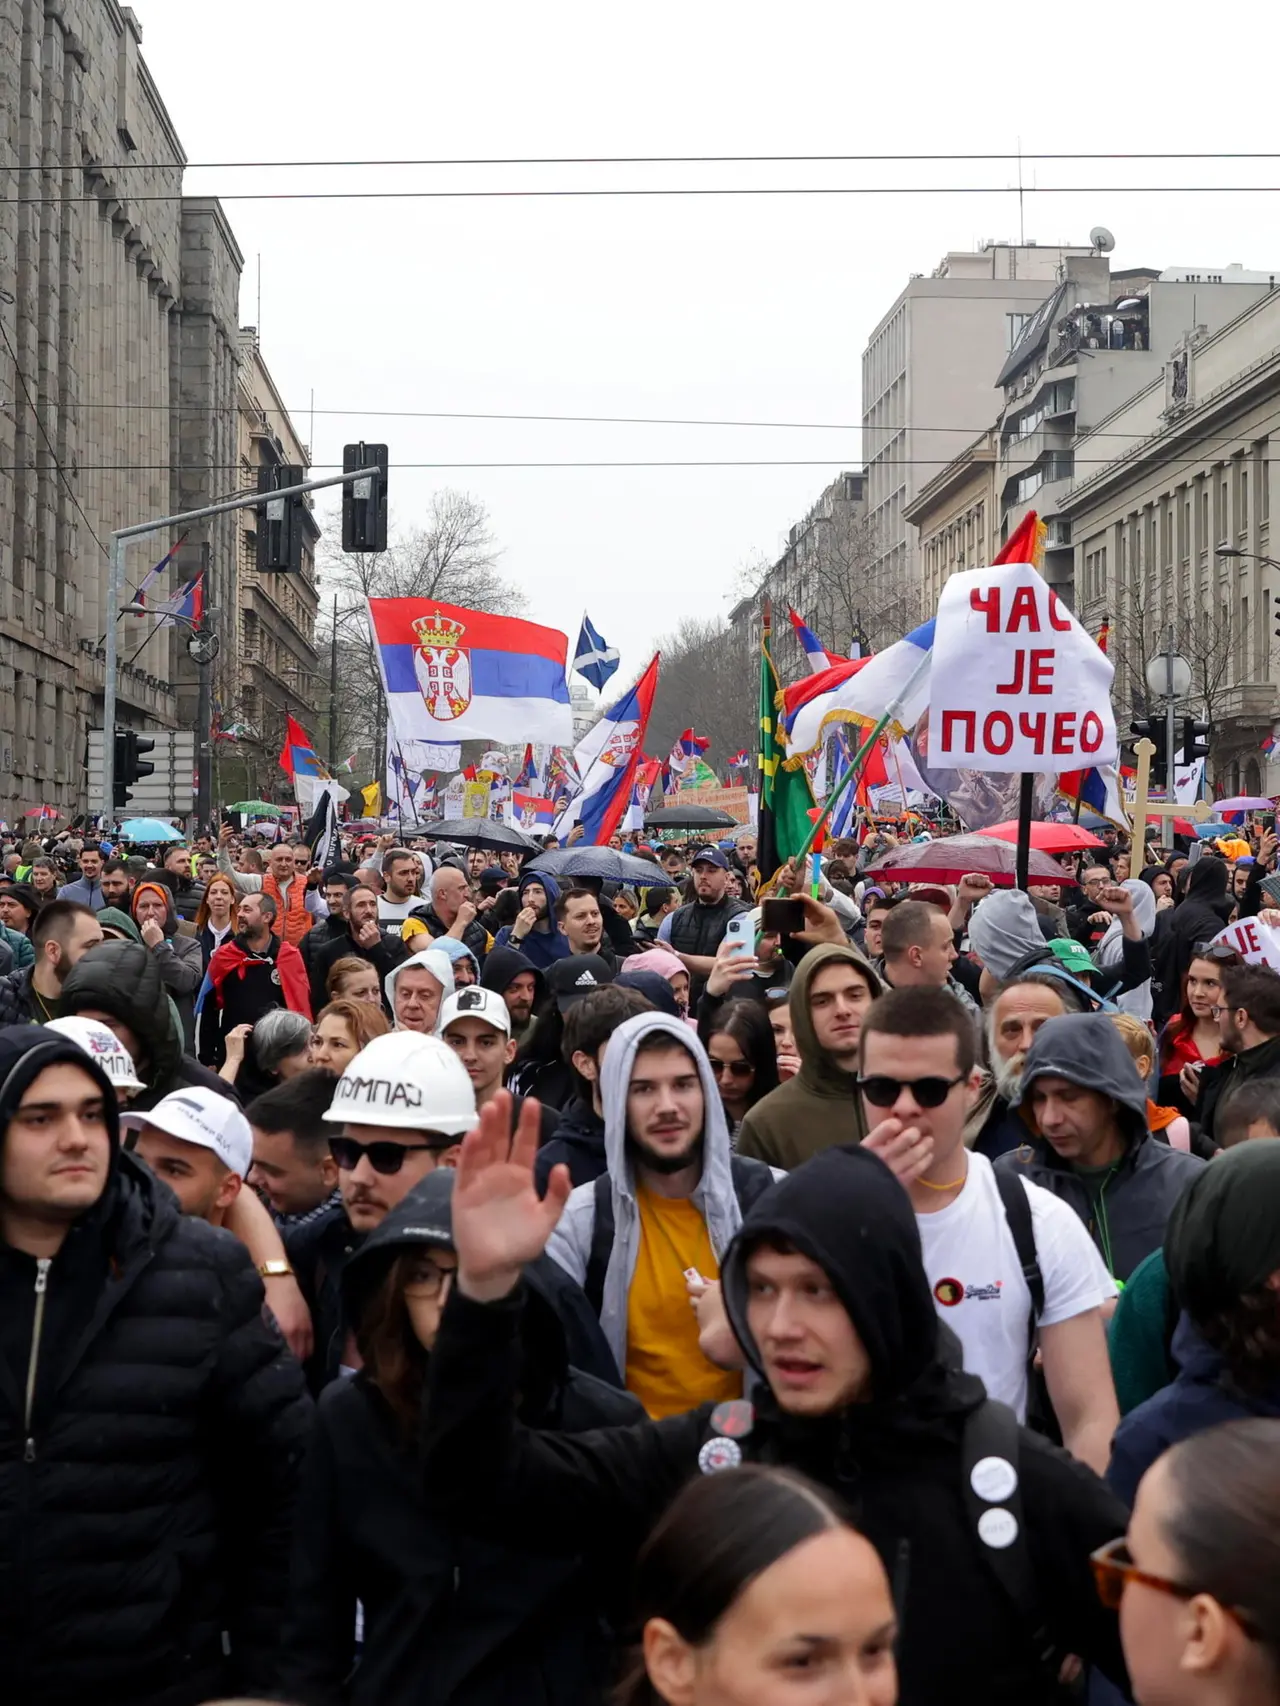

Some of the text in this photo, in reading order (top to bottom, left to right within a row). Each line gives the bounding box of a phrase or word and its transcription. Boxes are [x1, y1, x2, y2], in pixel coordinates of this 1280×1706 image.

[970, 586, 1072, 633] ЧАС
[996, 649, 1055, 695] ЈЕ
[941, 710, 1104, 755] ПОЧЕО
[386, 924, 404, 937] NIK
